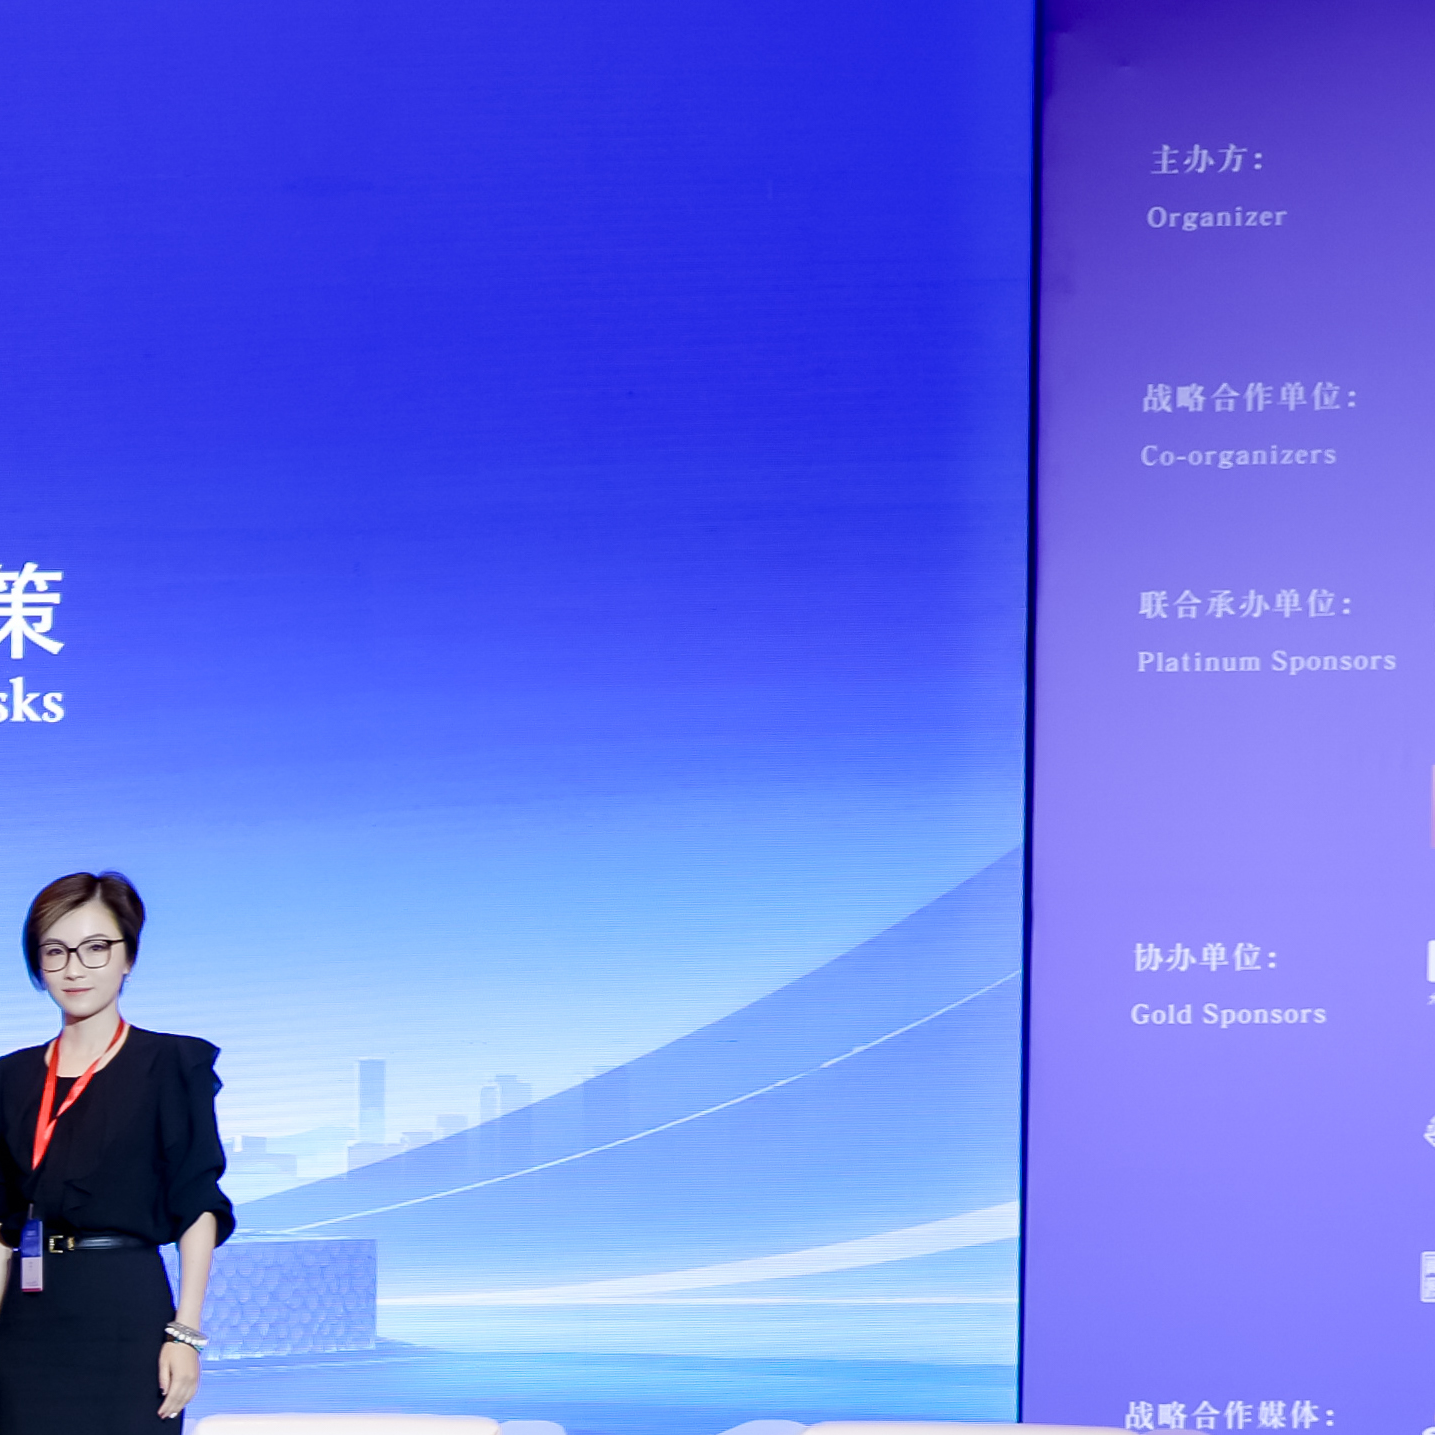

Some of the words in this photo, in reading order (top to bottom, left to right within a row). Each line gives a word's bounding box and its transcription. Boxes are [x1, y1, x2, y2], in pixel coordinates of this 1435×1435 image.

[1147, 206, 1287, 231] Organizer
[1140, 444, 1337, 469] Co-organizers
[1137, 651, 1261, 672] Platinum
[1271, 650, 1397, 675] Sponsors
[1131, 1003, 1192, 1025] Gold
[1202, 1003, 1327, 1028] Sponsors
